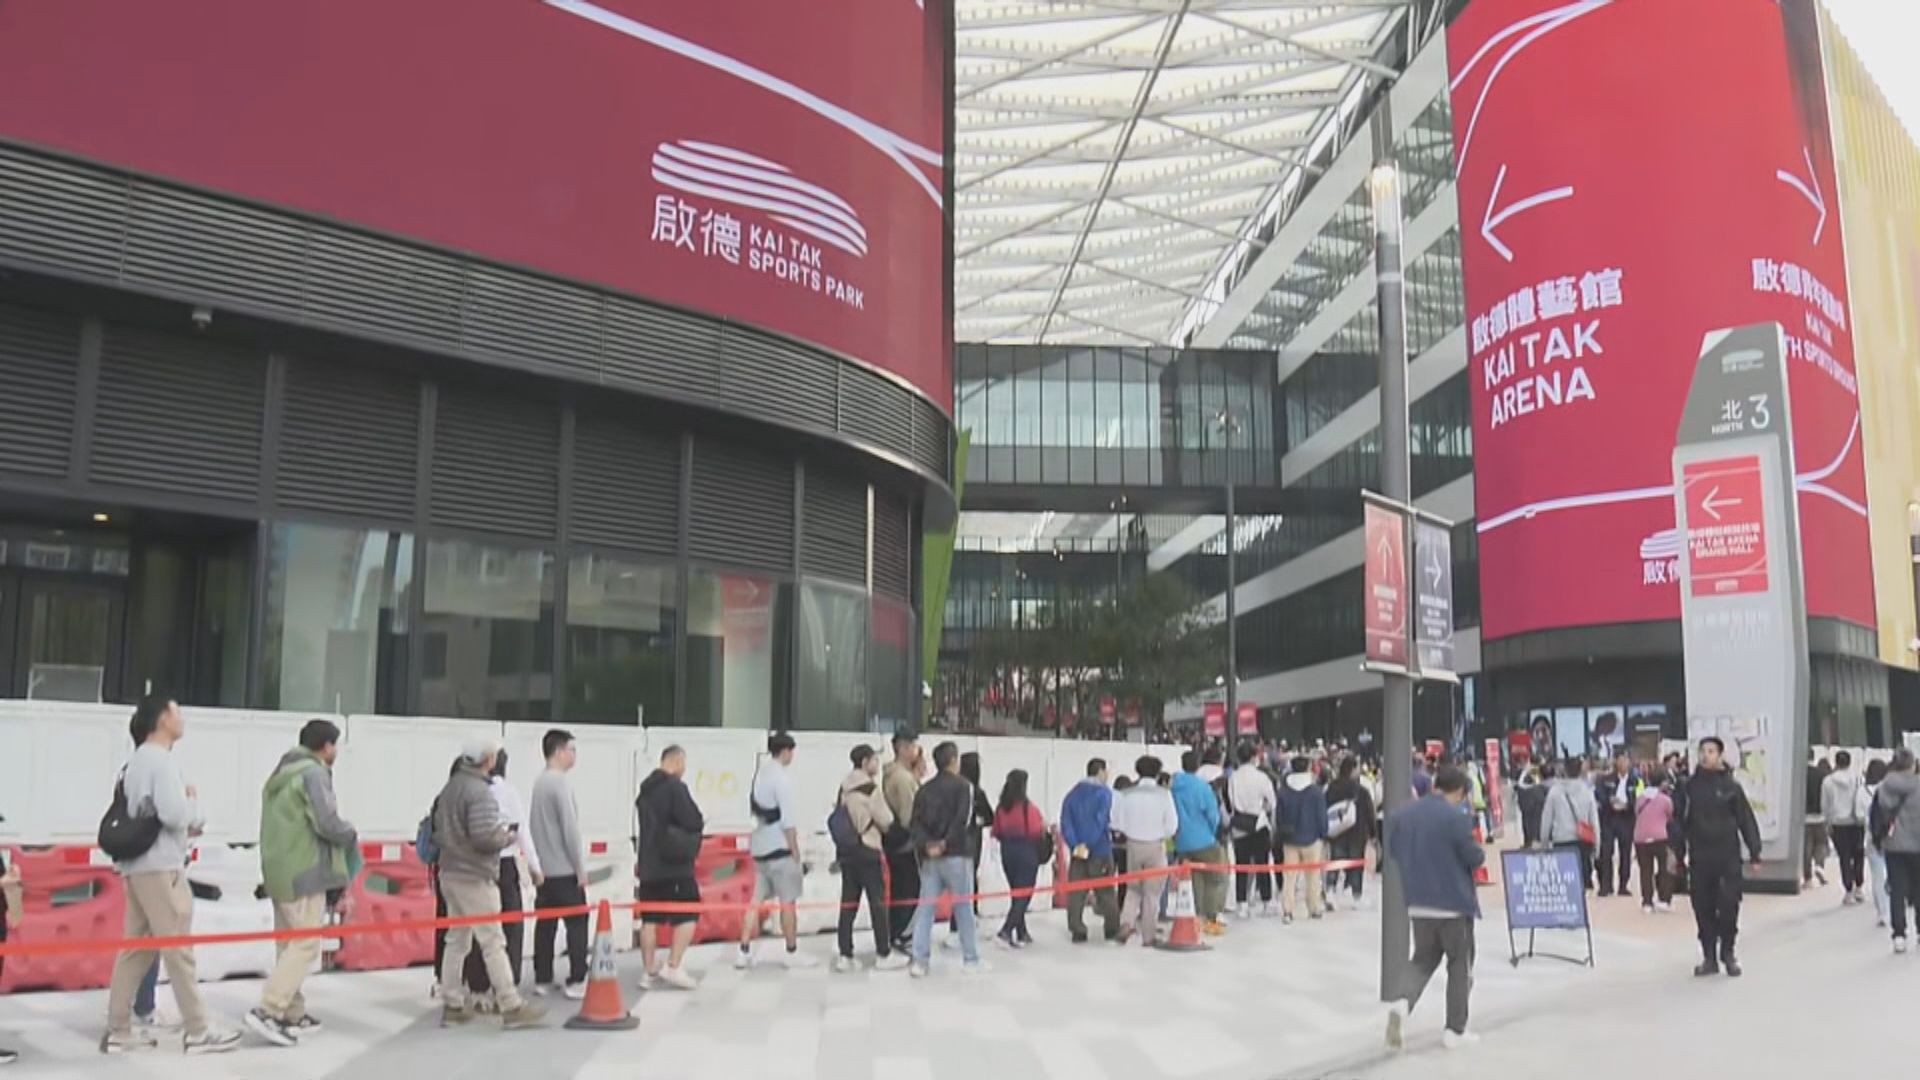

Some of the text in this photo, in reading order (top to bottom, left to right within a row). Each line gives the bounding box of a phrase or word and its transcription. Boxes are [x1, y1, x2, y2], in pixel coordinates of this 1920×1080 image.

[651, 194, 742, 264] 啟德
[750, 225, 822, 269] KAI TAK
[749, 250, 865, 310] SPORTS PARK
[1484, 319, 1603, 391] KAI TAK
[1491, 366, 1596, 430] ARENA
[1720, 393, 1770, 430] 北 3
